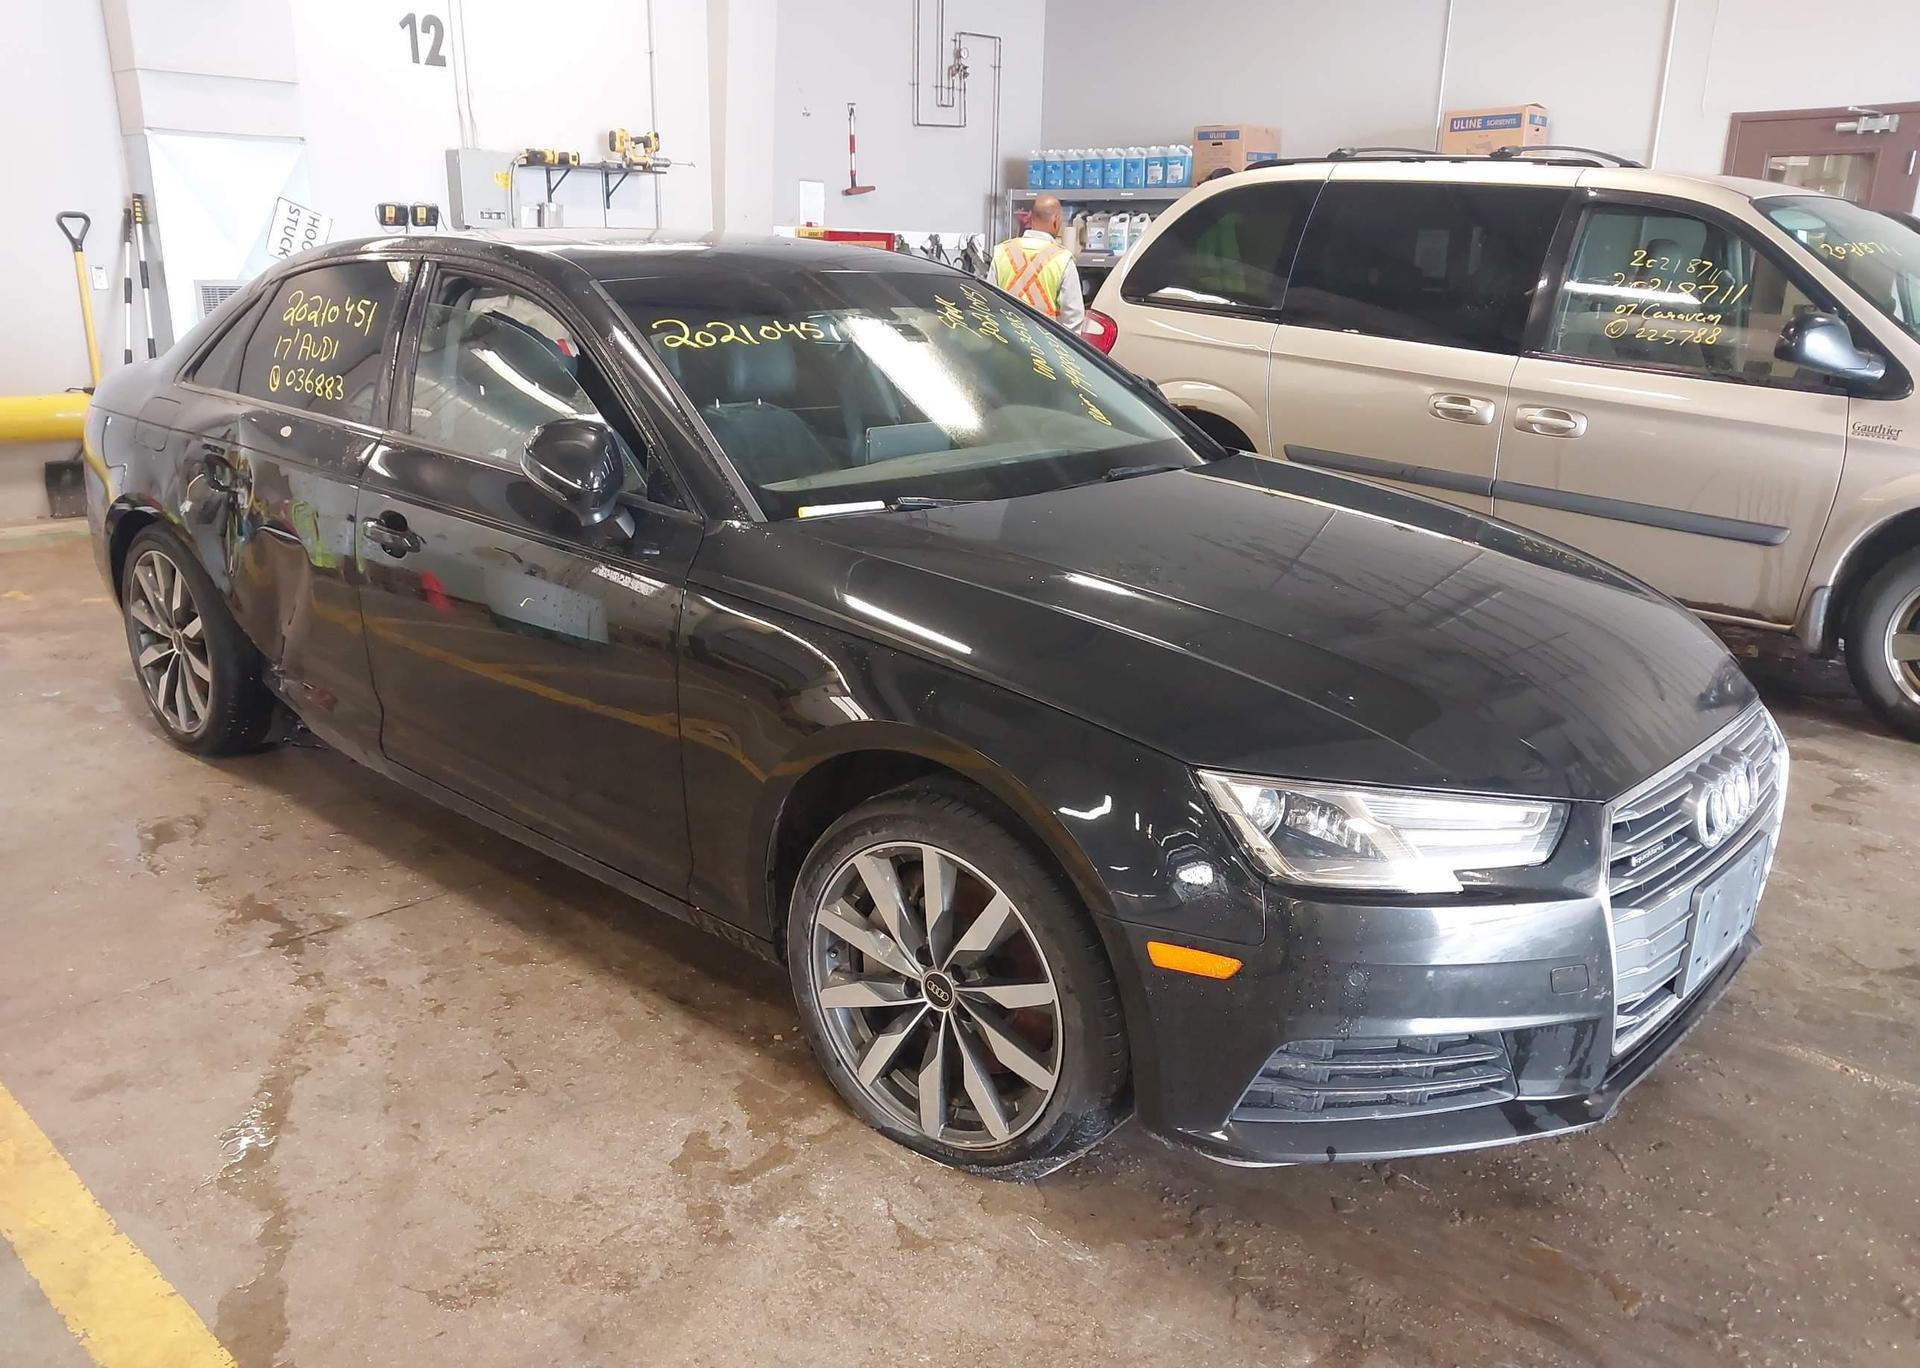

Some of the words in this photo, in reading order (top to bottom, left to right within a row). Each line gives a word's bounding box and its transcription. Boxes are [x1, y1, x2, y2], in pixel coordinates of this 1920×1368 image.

[399, 12, 446, 67] 12
[1453, 119, 1482, 130] ULINE
[278, 204, 301, 258] STUCK
[301, 215, 321, 251] HOO
[282, 290, 378, 336] 20210451
[652, 318, 842, 349] 20210451
[1635, 326, 1722, 347] 225788
[285, 367, 344, 400] 036883
[1852, 421, 1903, 437] Gauthier
